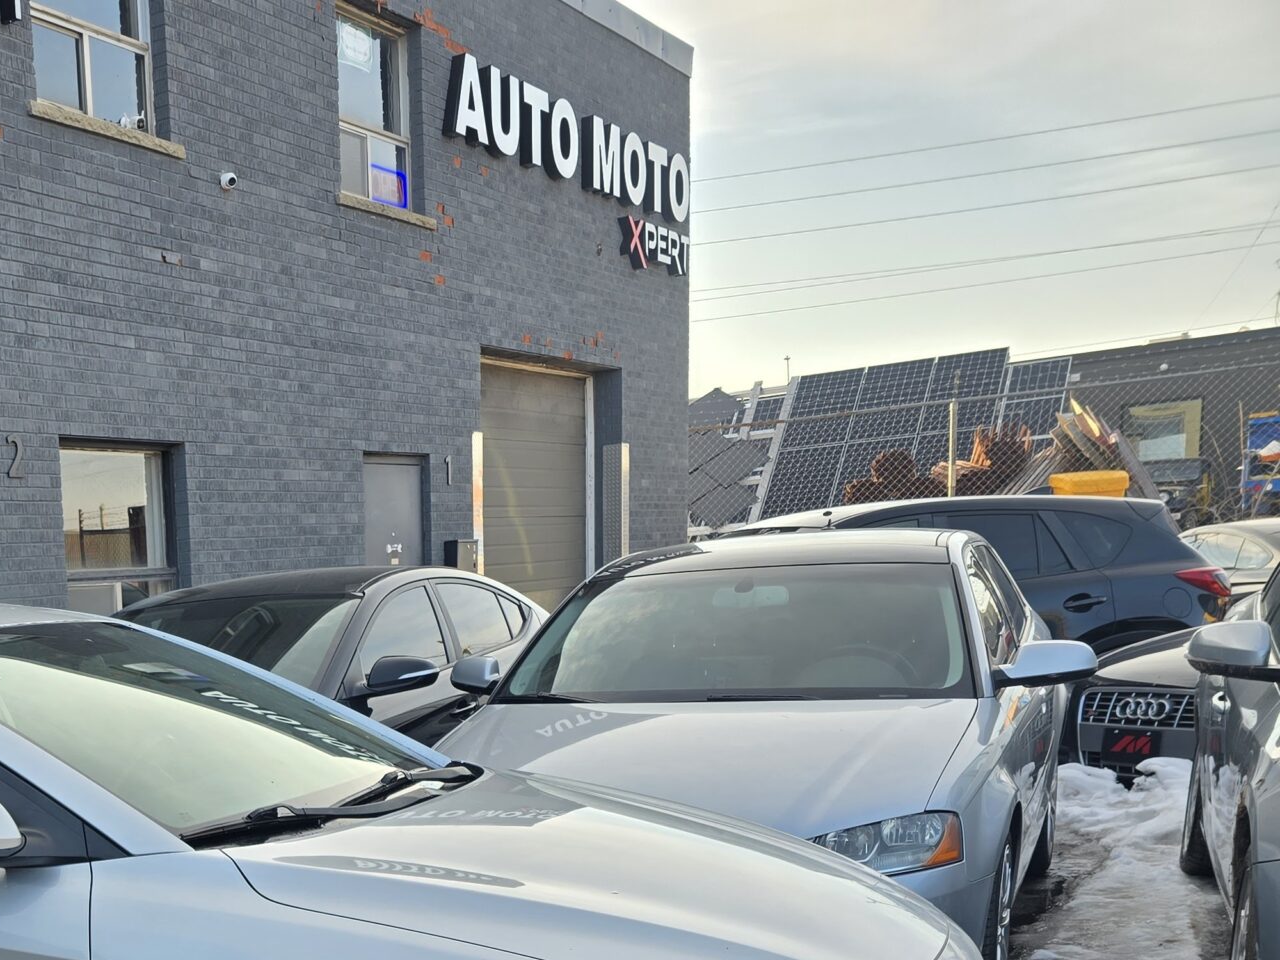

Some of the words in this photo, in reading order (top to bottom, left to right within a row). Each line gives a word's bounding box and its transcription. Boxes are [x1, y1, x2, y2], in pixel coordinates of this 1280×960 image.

[455, 53, 579, 179] AUTO
[592, 114, 690, 223] MOTO
[627, 214, 690, 276] XPERT
[6, 433, 25, 478] 2
[444, 455, 452, 486] 1
